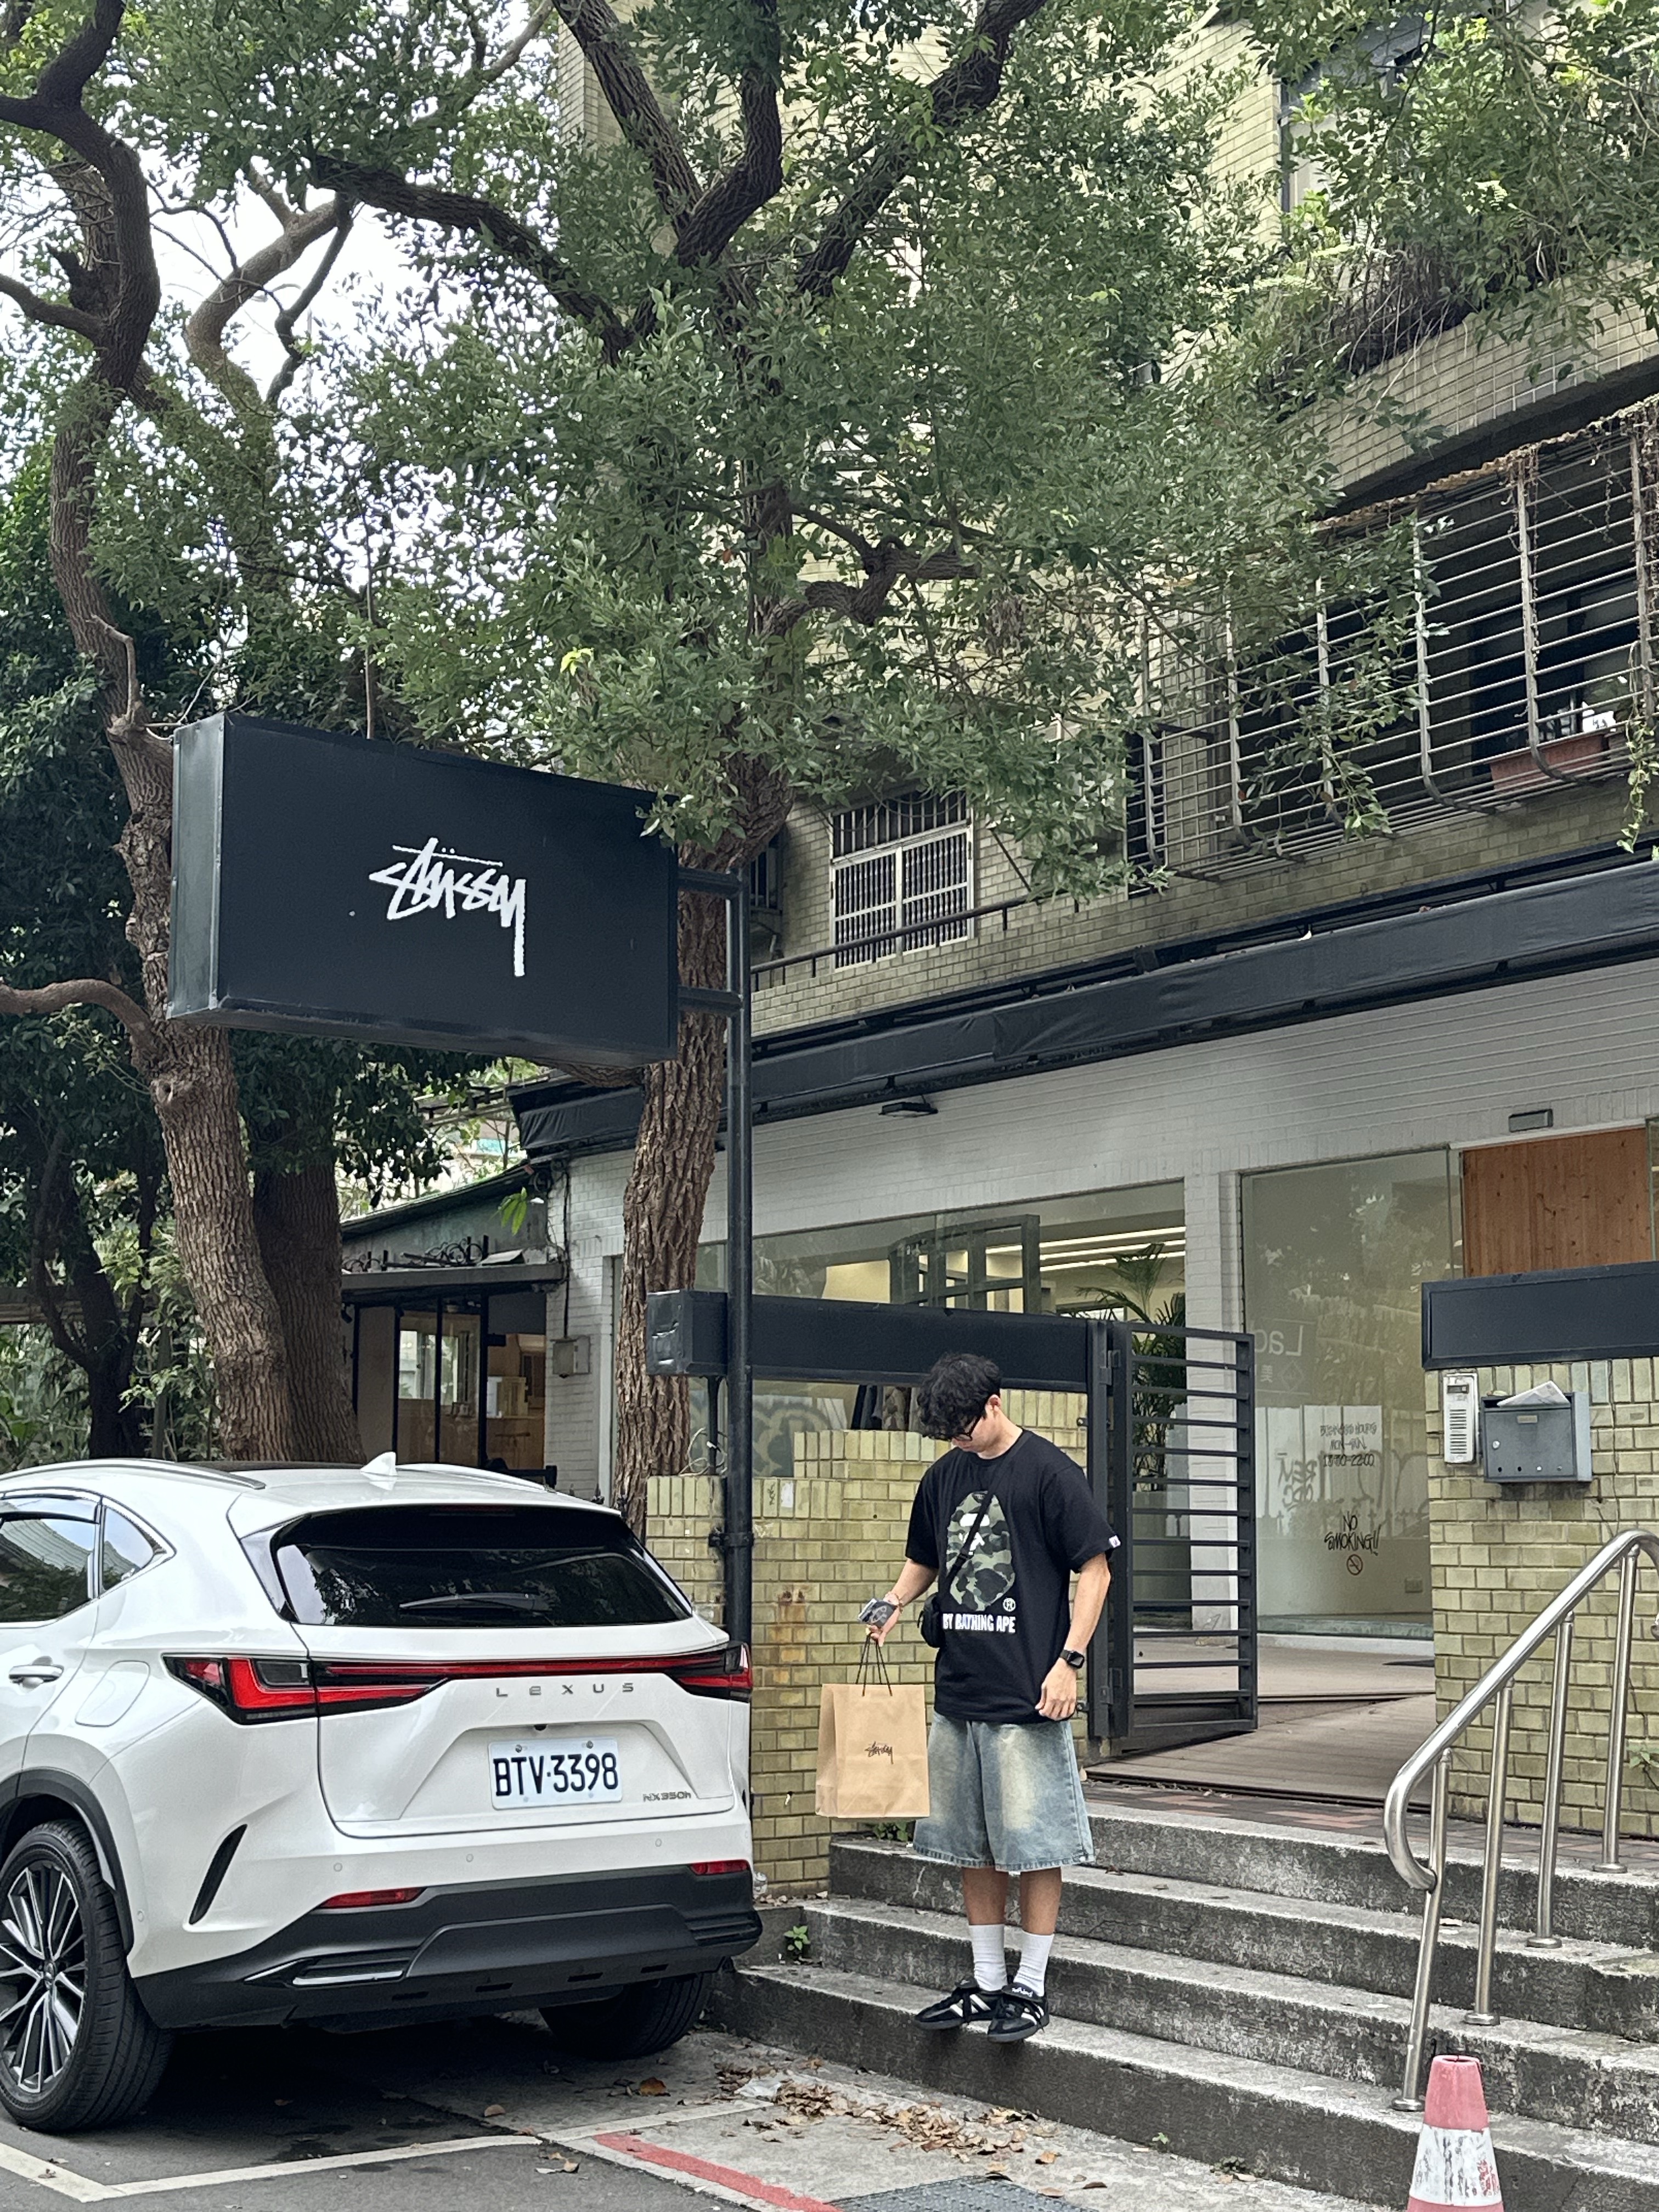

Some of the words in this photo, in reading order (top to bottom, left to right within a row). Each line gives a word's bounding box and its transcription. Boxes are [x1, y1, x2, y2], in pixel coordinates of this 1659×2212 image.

[1343, 1511, 1358, 1531] NO
[943, 1613, 953, 1629] BY
[955, 1613, 994, 1632] BATHING
[996, 1615, 1016, 1633] APE
[496, 1683, 634, 1697] LEXUS
